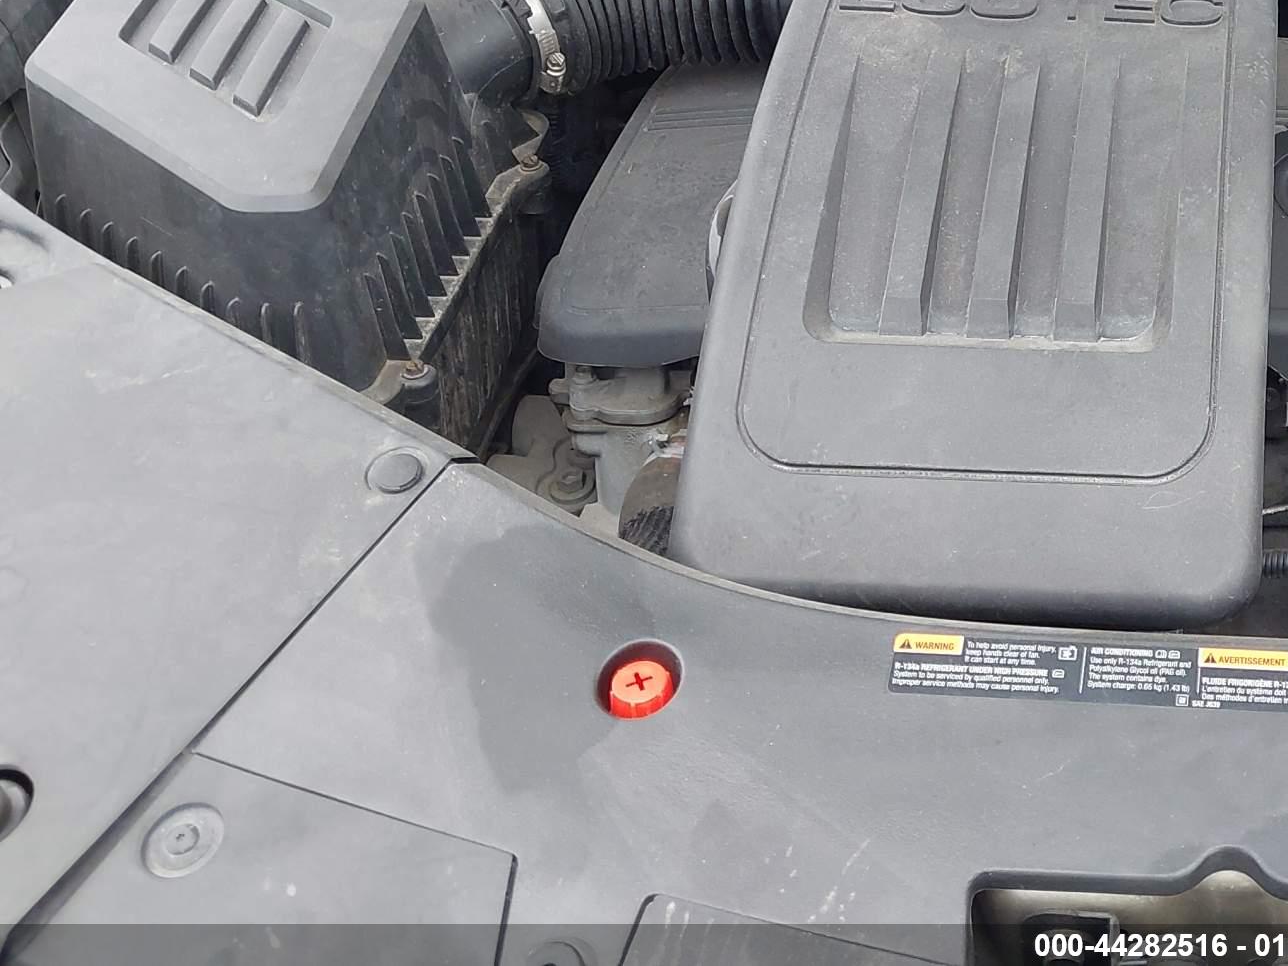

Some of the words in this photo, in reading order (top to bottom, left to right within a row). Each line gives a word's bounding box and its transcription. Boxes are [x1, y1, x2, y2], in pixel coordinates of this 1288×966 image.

[915, 641, 954, 649] WARNING
[1103, 658, 1117, 666] only
[1118, 658, 1142, 666] R-134a
[1143, 660, 1178, 669] Refrigerant
[1218, 656, 1286, 666] AVERTISSEMENT
